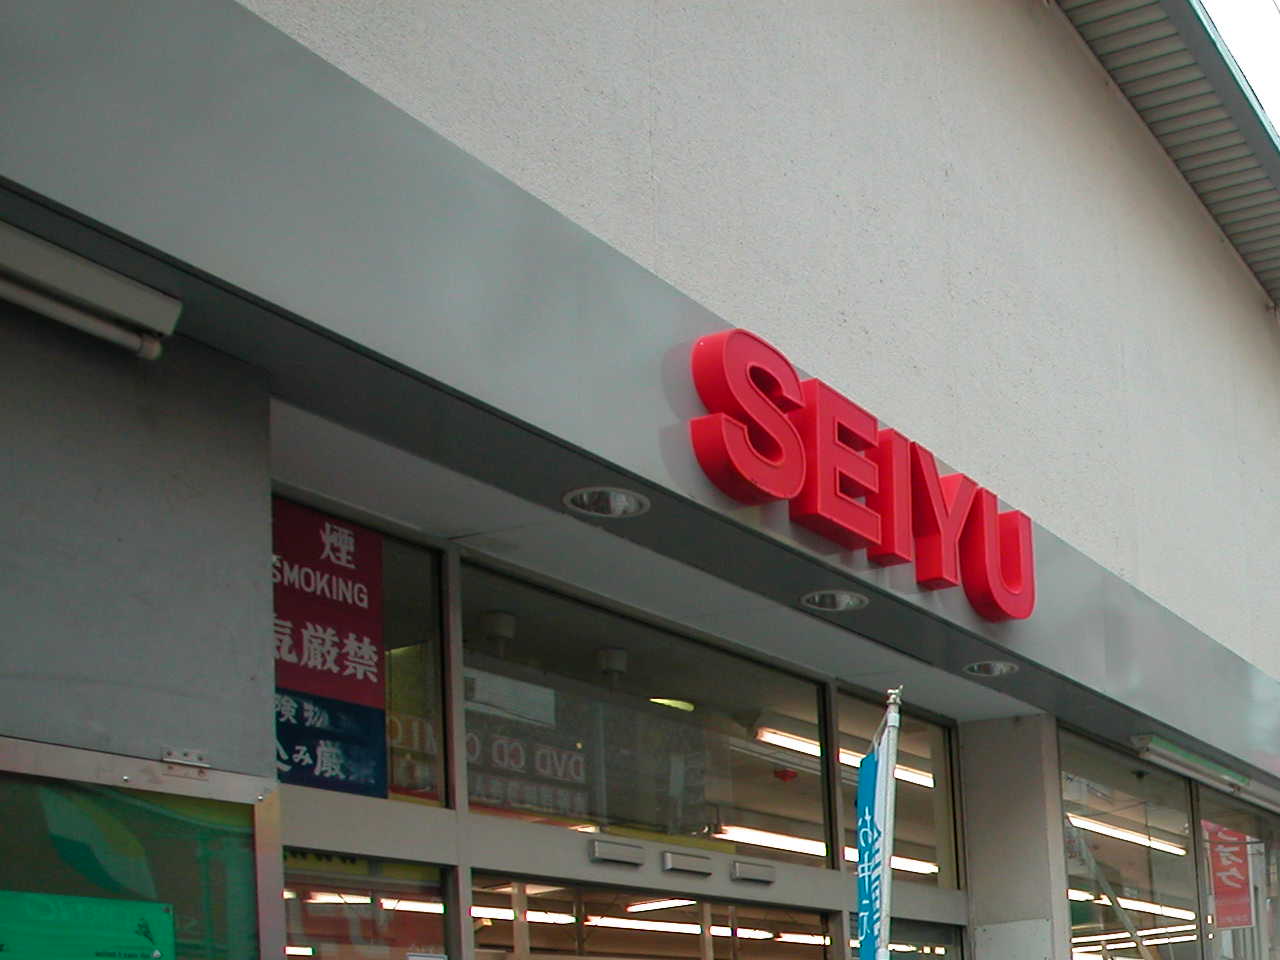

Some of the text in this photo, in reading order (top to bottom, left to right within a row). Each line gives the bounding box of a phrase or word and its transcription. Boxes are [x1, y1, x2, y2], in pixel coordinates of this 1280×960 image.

[690, 328, 1036, 623] SEIYU
[320, 521, 356, 569] 煙
[272, 554, 369, 609] SMOKING
